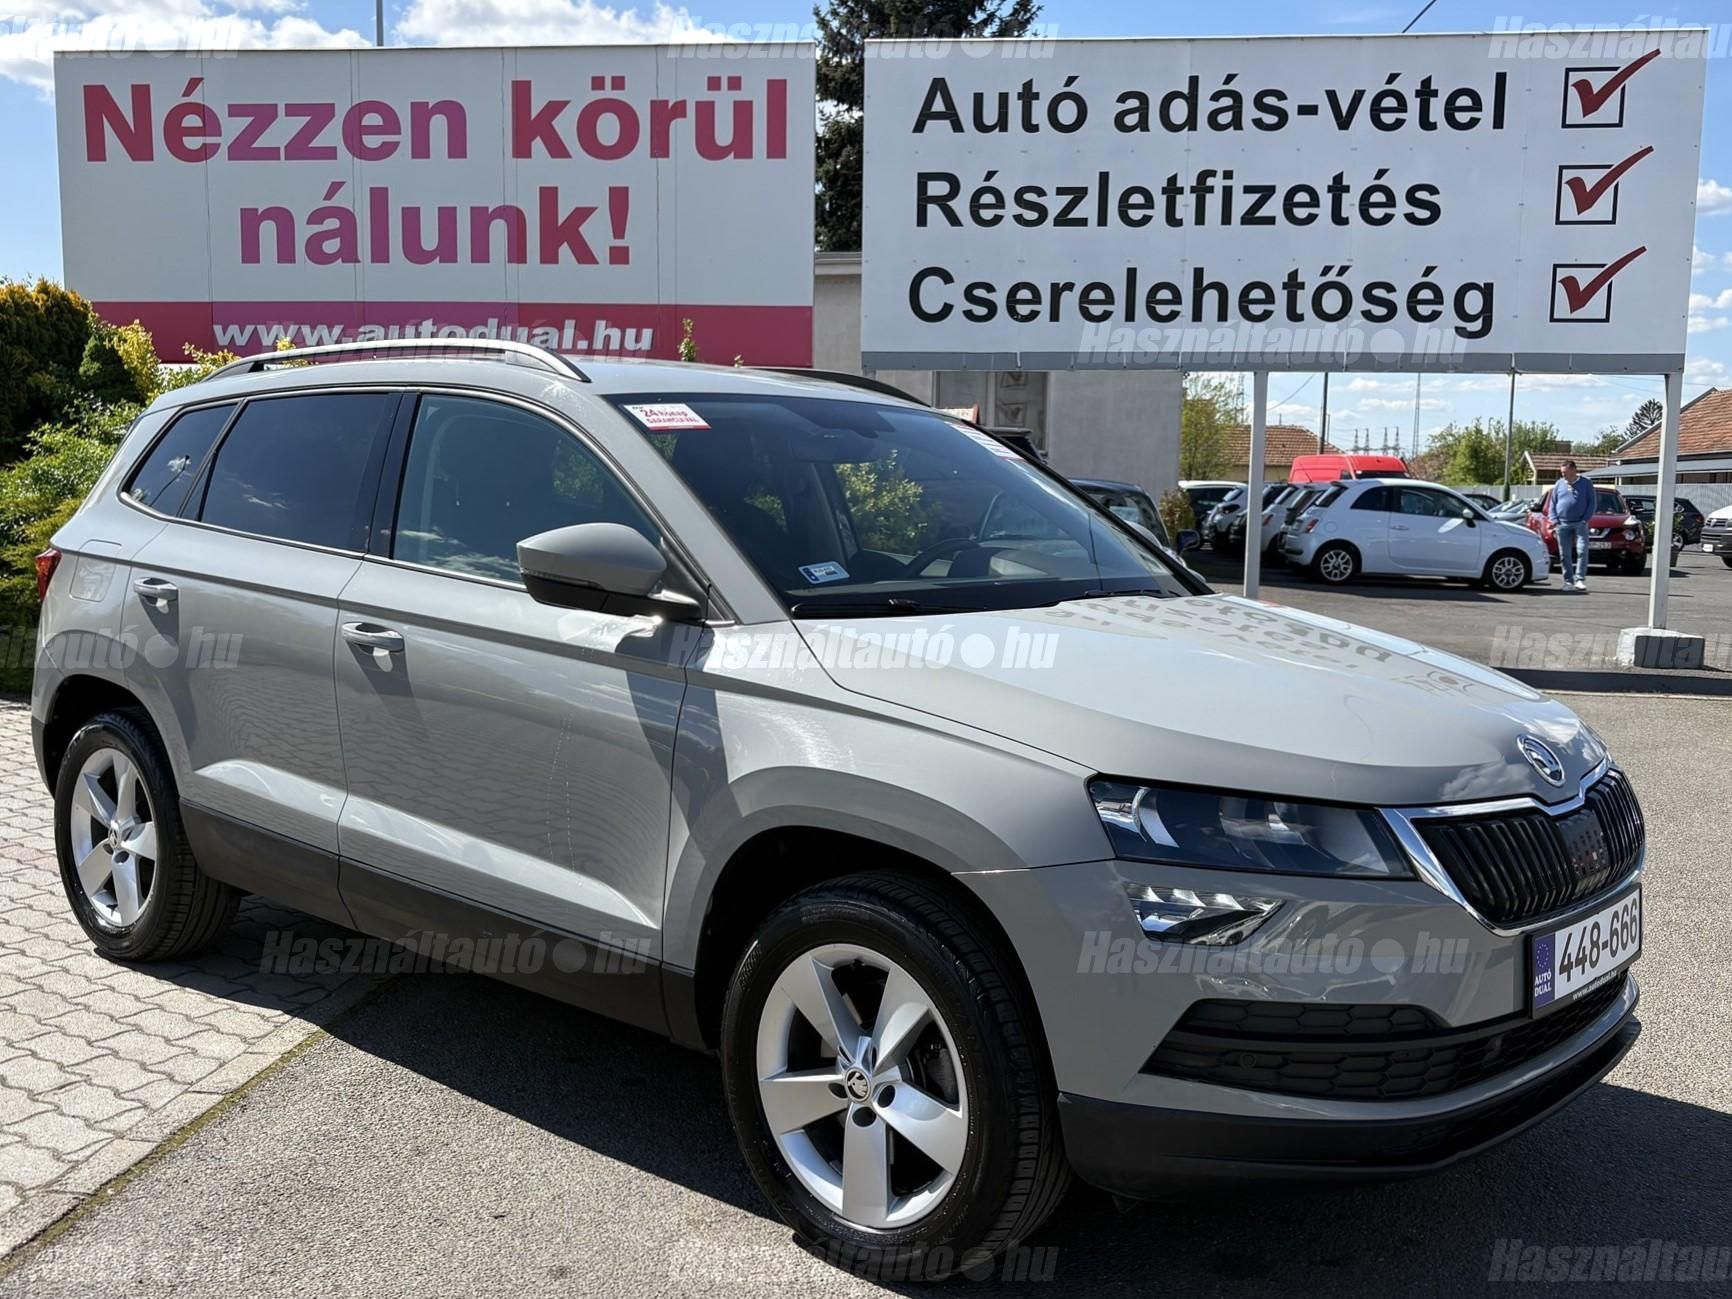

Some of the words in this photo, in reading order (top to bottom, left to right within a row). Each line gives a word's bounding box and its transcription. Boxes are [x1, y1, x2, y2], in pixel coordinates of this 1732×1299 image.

[83, 77, 467, 162] Nézzen
[513, 77, 787, 160] körül
[911, 76, 1088, 133] Autó
[1114, 72, 1506, 133] adás-vétel
[240, 180, 630, 265] nálunk!
[917, 169, 1442, 227] Részletfizetés
[909, 266, 1494, 339] Cserelehetőség
[1559, 898, 1638, 983] 448-666
